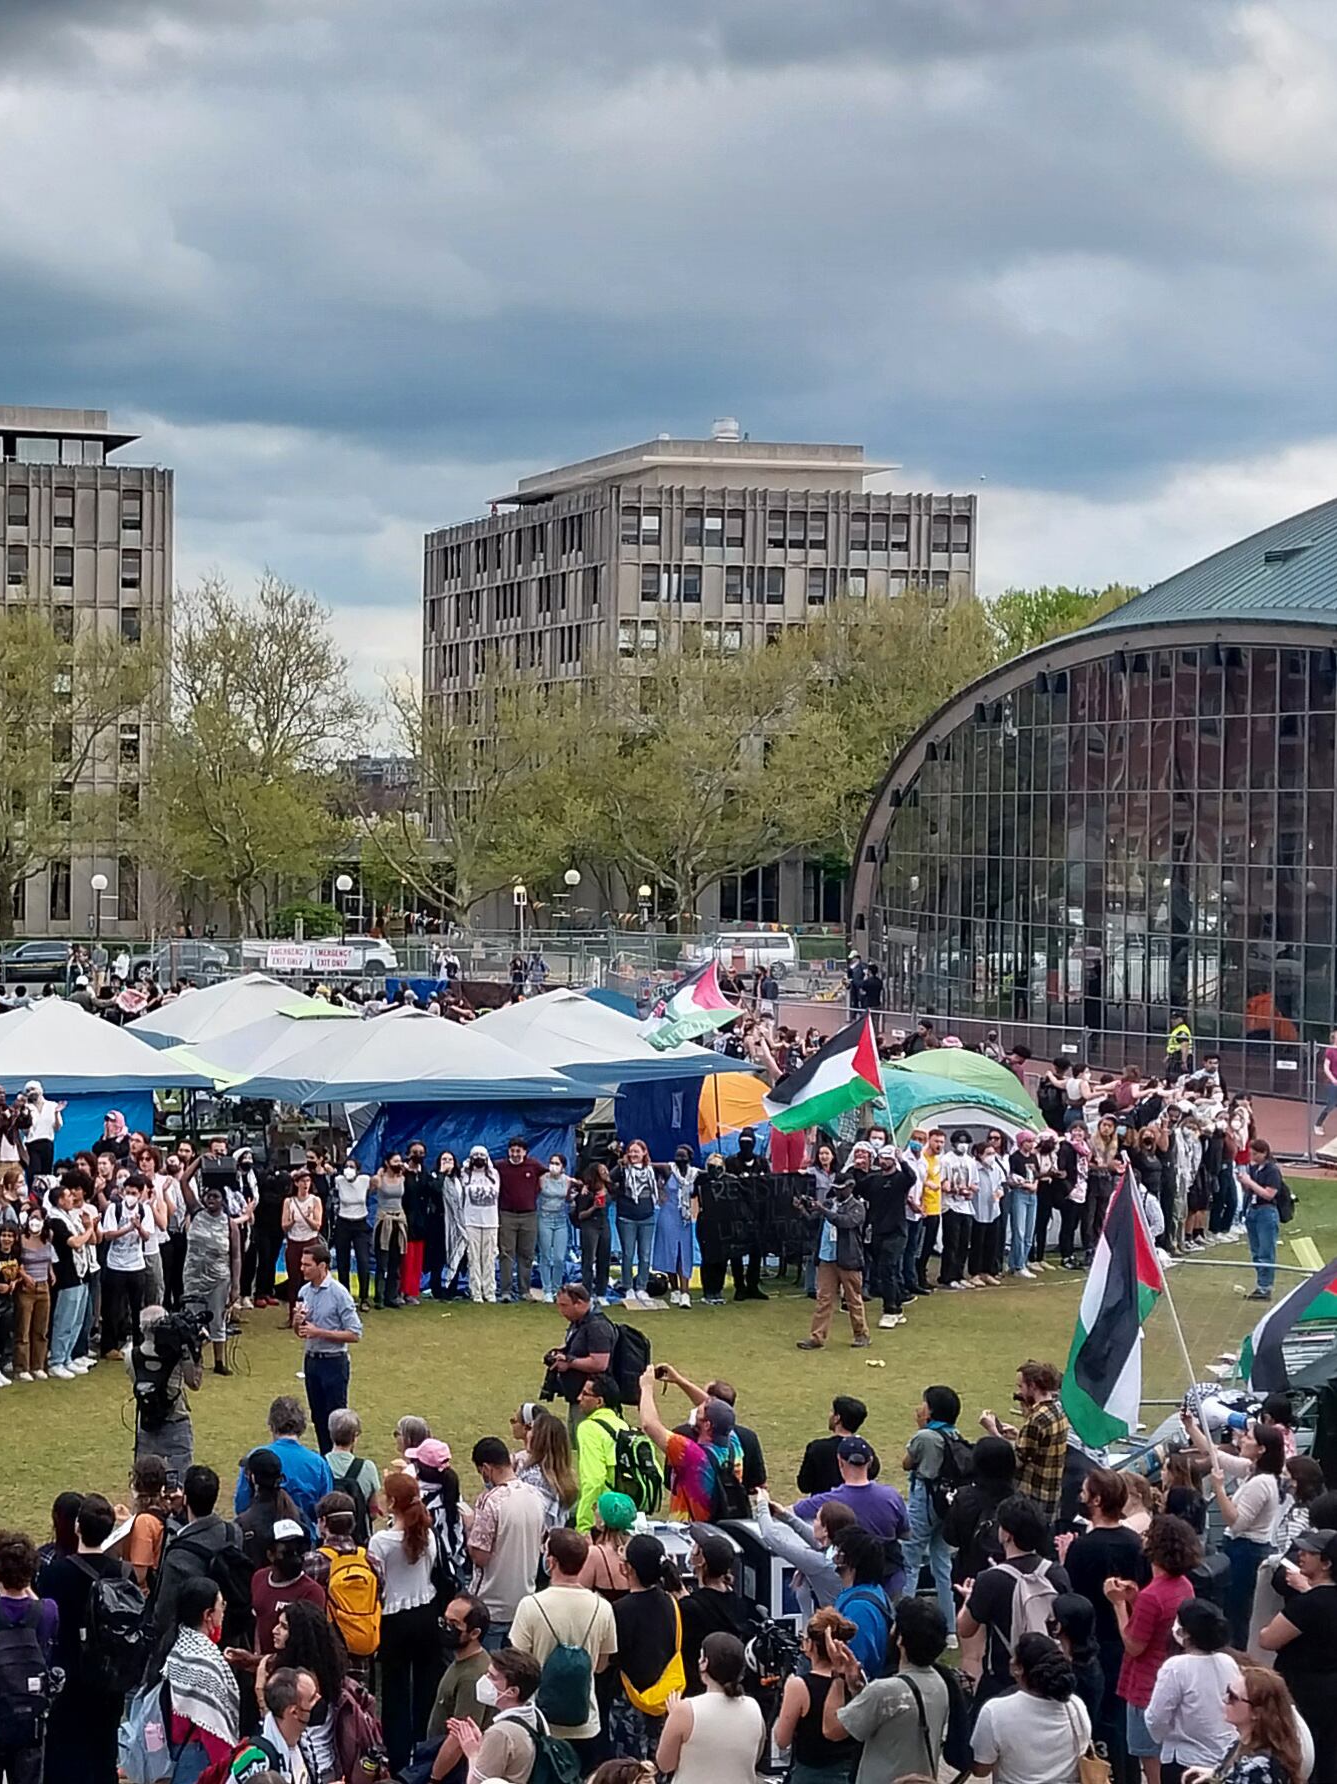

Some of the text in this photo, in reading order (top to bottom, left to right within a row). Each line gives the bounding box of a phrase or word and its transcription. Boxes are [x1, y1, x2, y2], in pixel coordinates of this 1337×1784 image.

[270, 948, 308, 956] EMERGENCY
[315, 949, 352, 957] EMERGENCY
[273, 957, 303, 966] EXIT ONLY
[317, 959, 348, 967] EXIT ONLY
